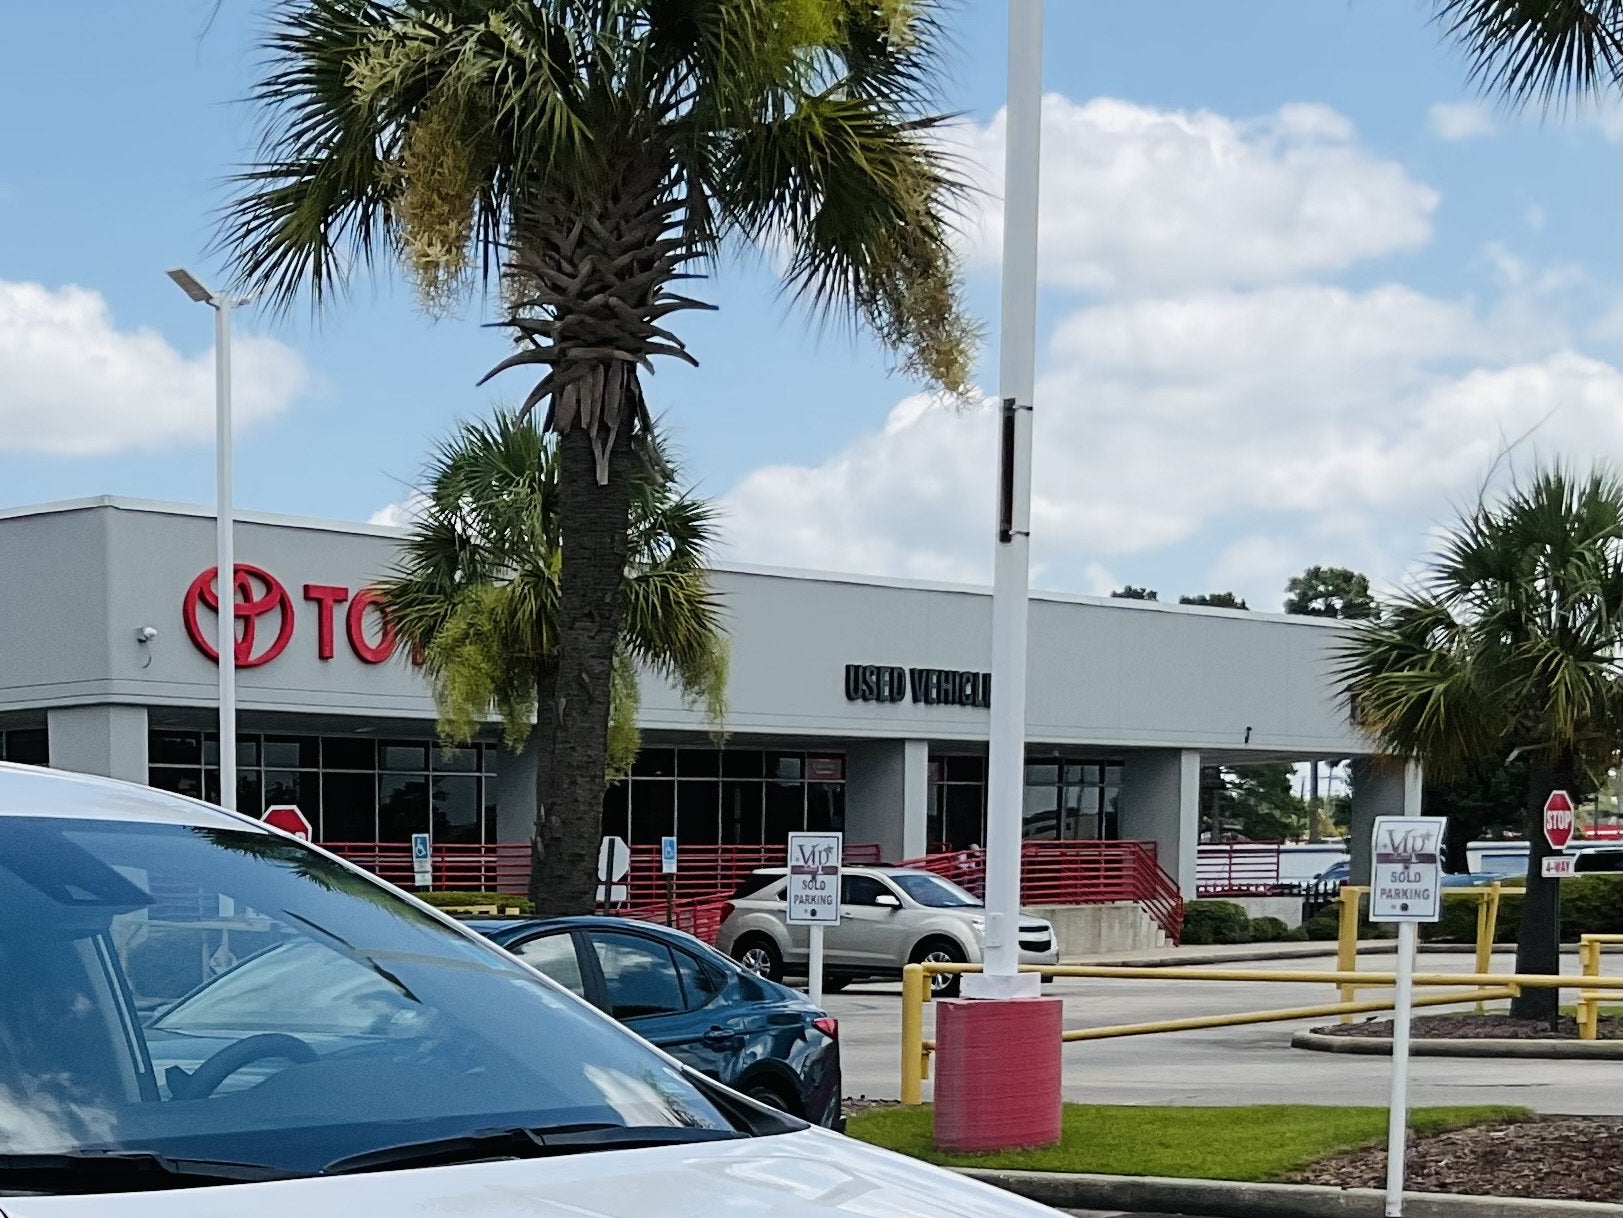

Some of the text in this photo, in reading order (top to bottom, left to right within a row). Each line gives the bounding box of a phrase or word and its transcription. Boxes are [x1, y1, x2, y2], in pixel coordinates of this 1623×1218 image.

[845, 664, 906, 702] USED
[1546, 810, 1571, 830] STOP
[1545, 861, 1570, 873] 4-WAY
[1390, 871, 1421, 883] SOLD
[802, 879, 826, 891] SOLD
[794, 894, 833, 905] PARKING
[1380, 888, 1430, 900] PARKING
